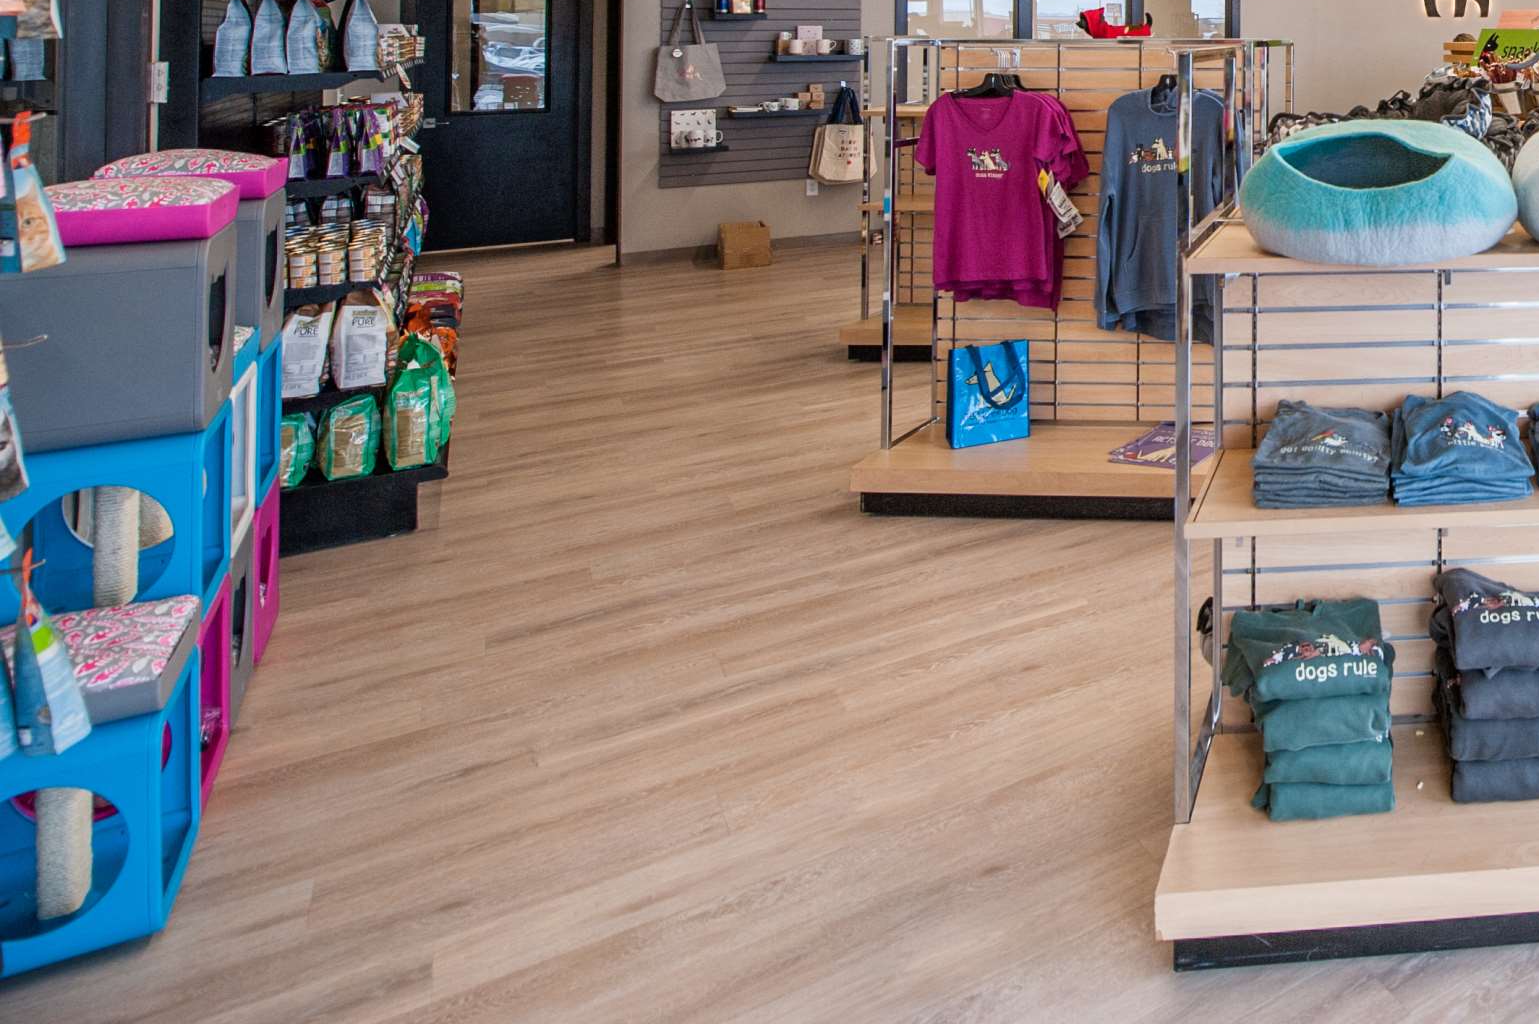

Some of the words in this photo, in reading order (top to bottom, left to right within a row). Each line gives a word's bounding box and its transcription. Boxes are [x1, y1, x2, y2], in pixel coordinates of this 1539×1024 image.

[352, 318, 376, 328] PURE
[294, 327, 320, 337] PURE
[1480, 609, 1521, 625] dogs
[1295, 661, 1338, 682] dogs
[1343, 658, 1378, 677] rule
